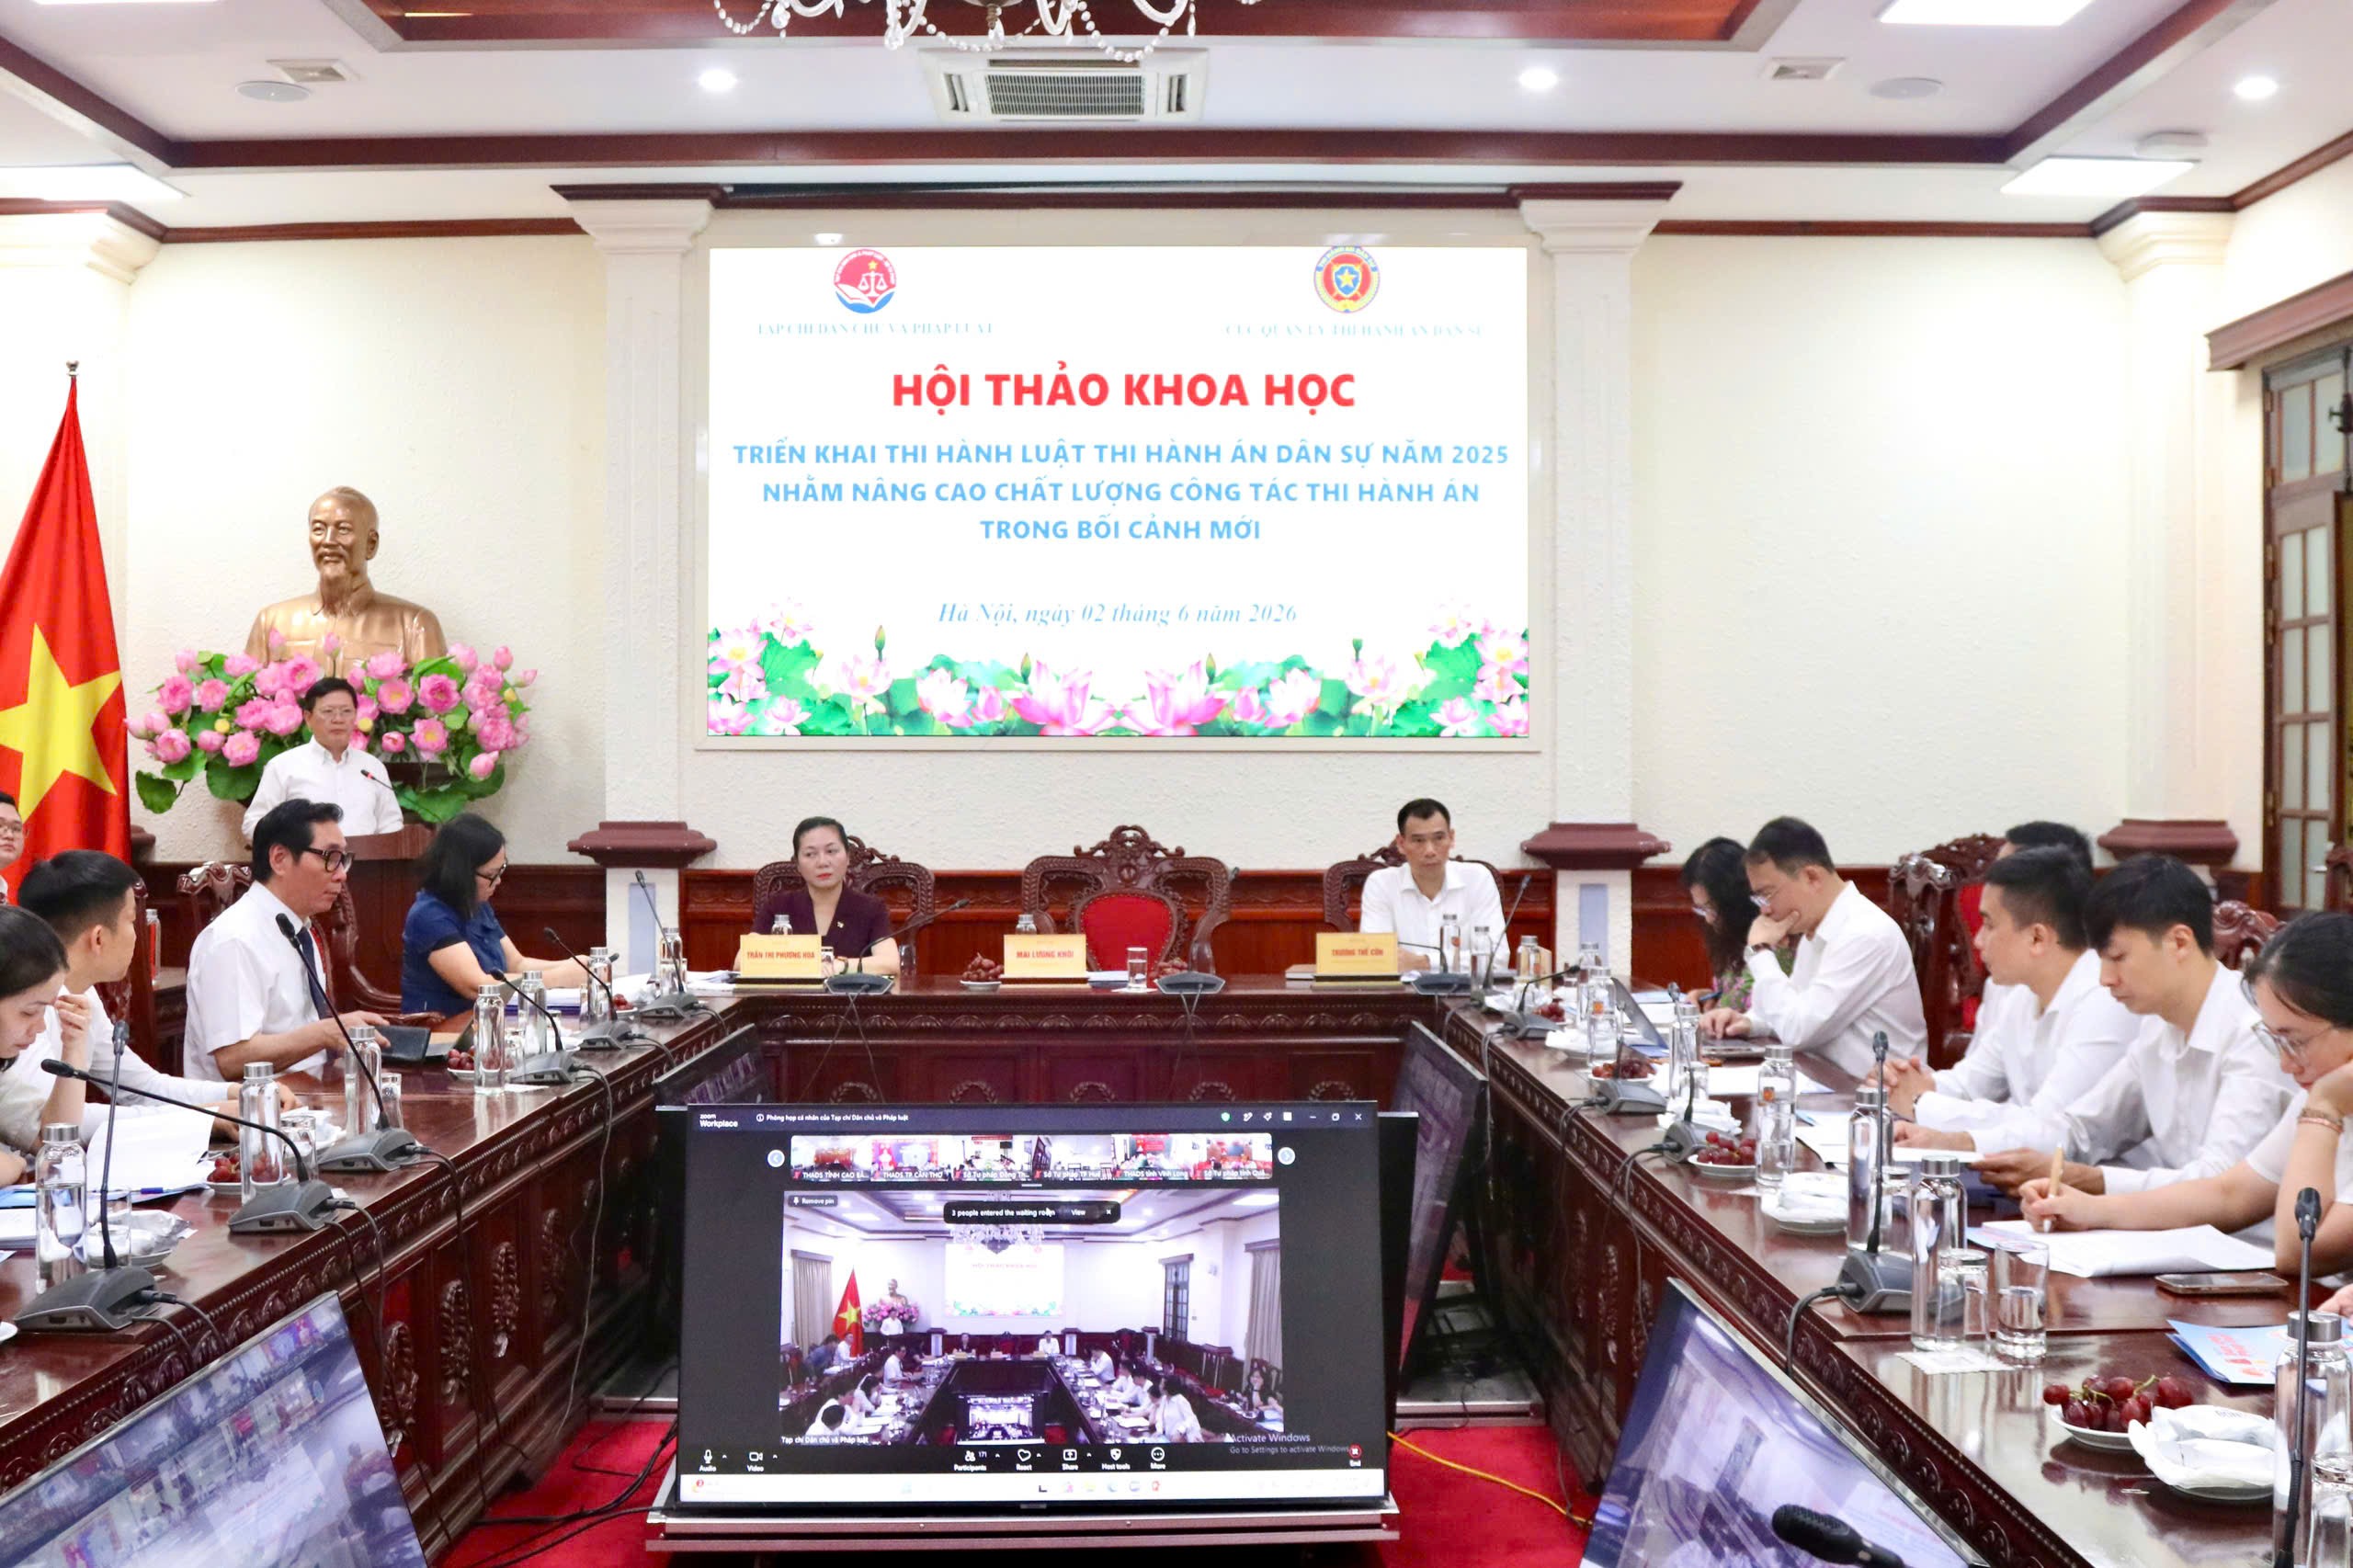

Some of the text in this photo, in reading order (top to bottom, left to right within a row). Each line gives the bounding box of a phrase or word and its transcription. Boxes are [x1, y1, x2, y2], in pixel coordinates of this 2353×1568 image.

[894, 360, 1355, 415] HỘI THẢO KHOA HỌC
[733, 437, 1508, 467] TRIỂN KHAI THI HÀNH LUẬT THI HÀNH ÁN DÂN SỰ NĂM 2025
[763, 473, 1479, 506] NHẰM NÂNG CAO CHẤT LƯỢNG CÔNG TÁC THI HÀNH ÁN
[980, 513, 1260, 540] TRONG BỐI CẢNH MỚI
[938, 603, 1297, 627] Hà Nội, ngày 02 tháng 6 năm 2026
[802, 951, 815, 960] HOA
[1016, 950, 1030, 959] MAI
[699, 1119, 739, 1130] Workplace
[801, 1197, 824, 1206] Remove
[957, 1210, 979, 1218] people
[1015, 1209, 1038, 1218] waiting
[1268, 1432, 1311, 1442] Windows
[1230, 1446, 1241, 1454] Go
[1242, 1446, 1250, 1454] to
[1251, 1446, 1279, 1456] Settings
[1289, 1445, 1317, 1453] activate
[699, 1464, 717, 1472] Audio
[746, 1464, 765, 1472] Video
[953, 1463, 987, 1472] Participants
[1062, 1462, 1079, 1471] Share
[1101, 1462, 1117, 1471] Host
[1150, 1461, 1166, 1470] More
